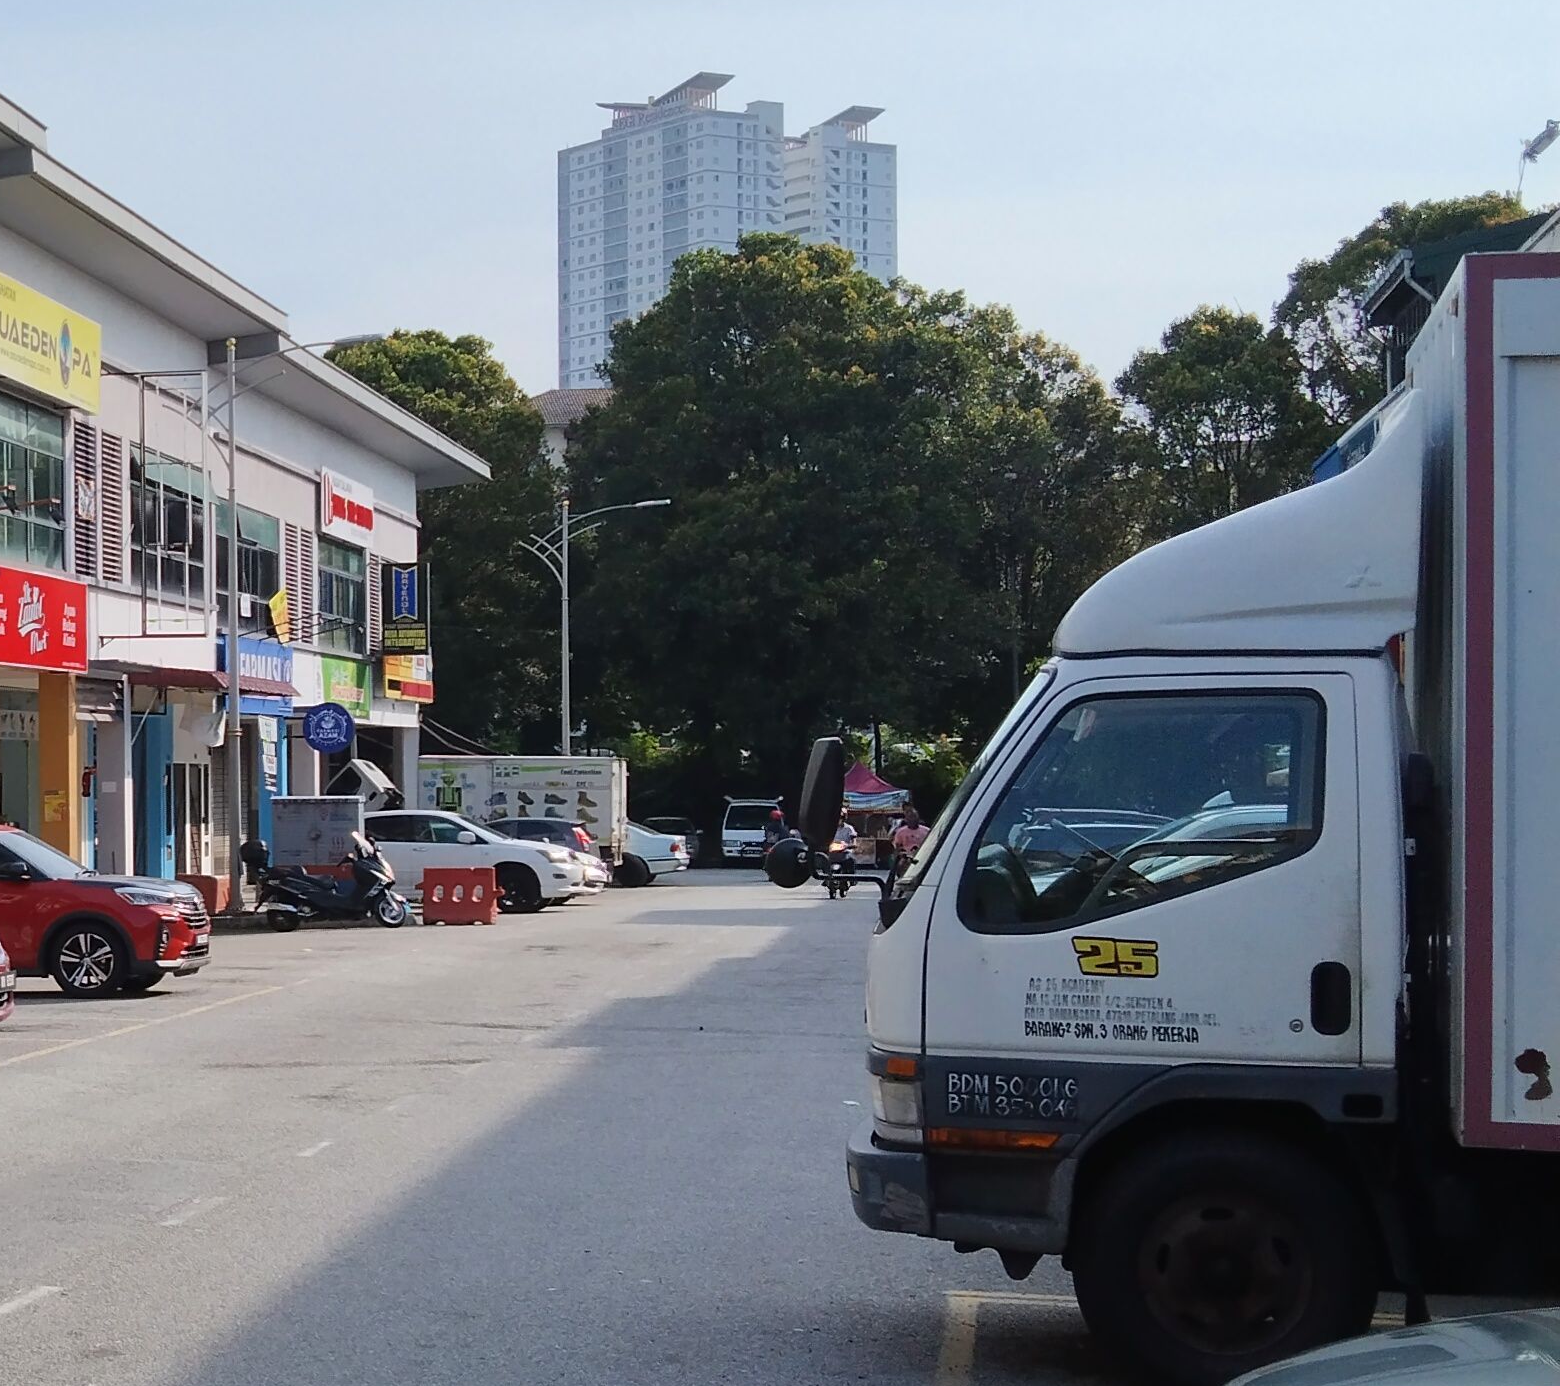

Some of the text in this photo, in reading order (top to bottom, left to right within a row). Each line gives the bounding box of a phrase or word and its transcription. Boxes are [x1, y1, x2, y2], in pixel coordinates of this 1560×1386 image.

[240, 652, 281, 682] FARMASI
[1071, 936, 1159, 978] 25
[1061, 978, 1105, 994] ACADEMY
[1112, 1025, 1148, 1041] ORANG
[1151, 1027, 1200, 1043] PEKERJA
[948, 1073, 989, 1093] BDM
